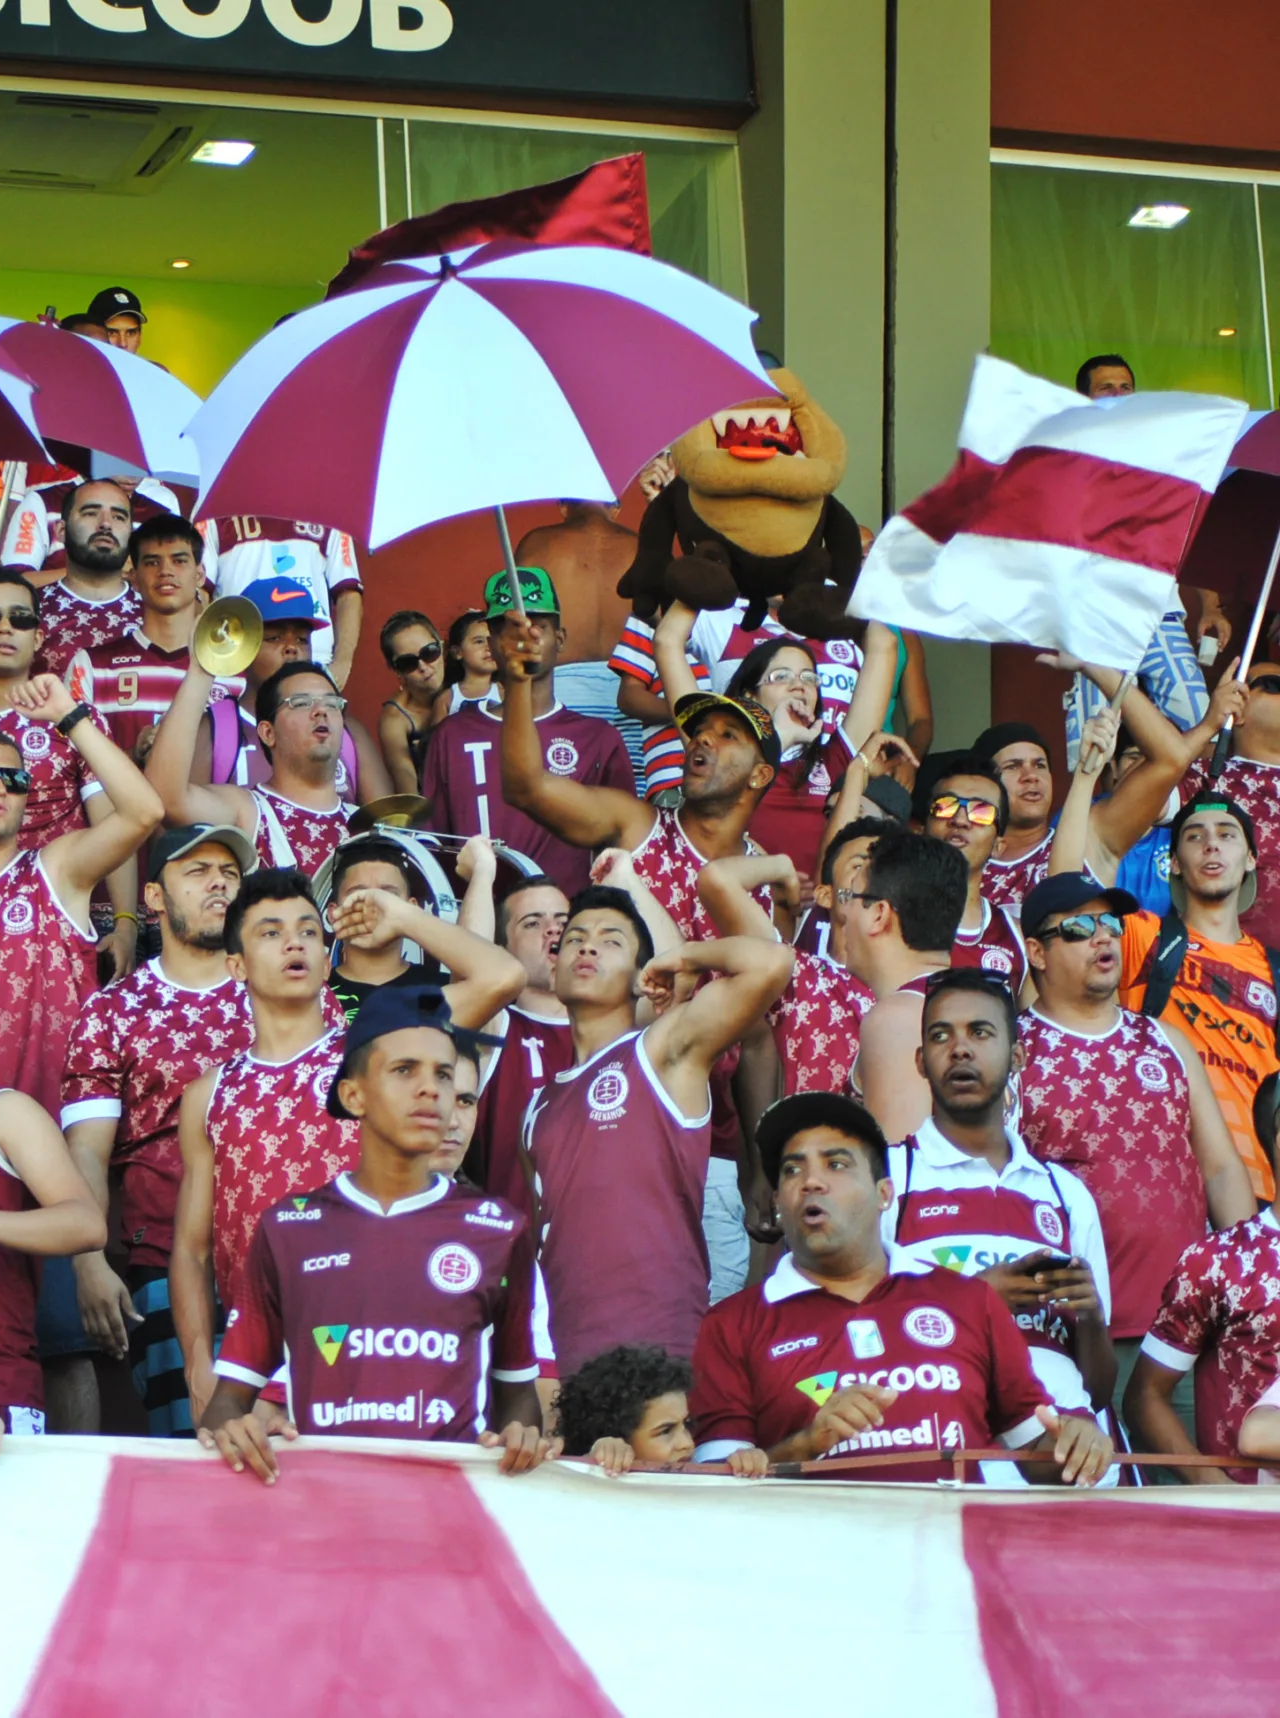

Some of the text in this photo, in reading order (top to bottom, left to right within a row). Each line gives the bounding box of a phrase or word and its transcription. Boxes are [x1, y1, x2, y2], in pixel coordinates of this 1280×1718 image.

[14, 512, 37, 555] BMG
[231, 515, 261, 541] 10
[117, 672, 140, 706] 9
[277, 1208, 322, 1223] SICOOB
[465, 1213, 514, 1231] Unimed
[348, 1327, 460, 1363] SICOOB
[312, 1395, 416, 1428] Unimed
